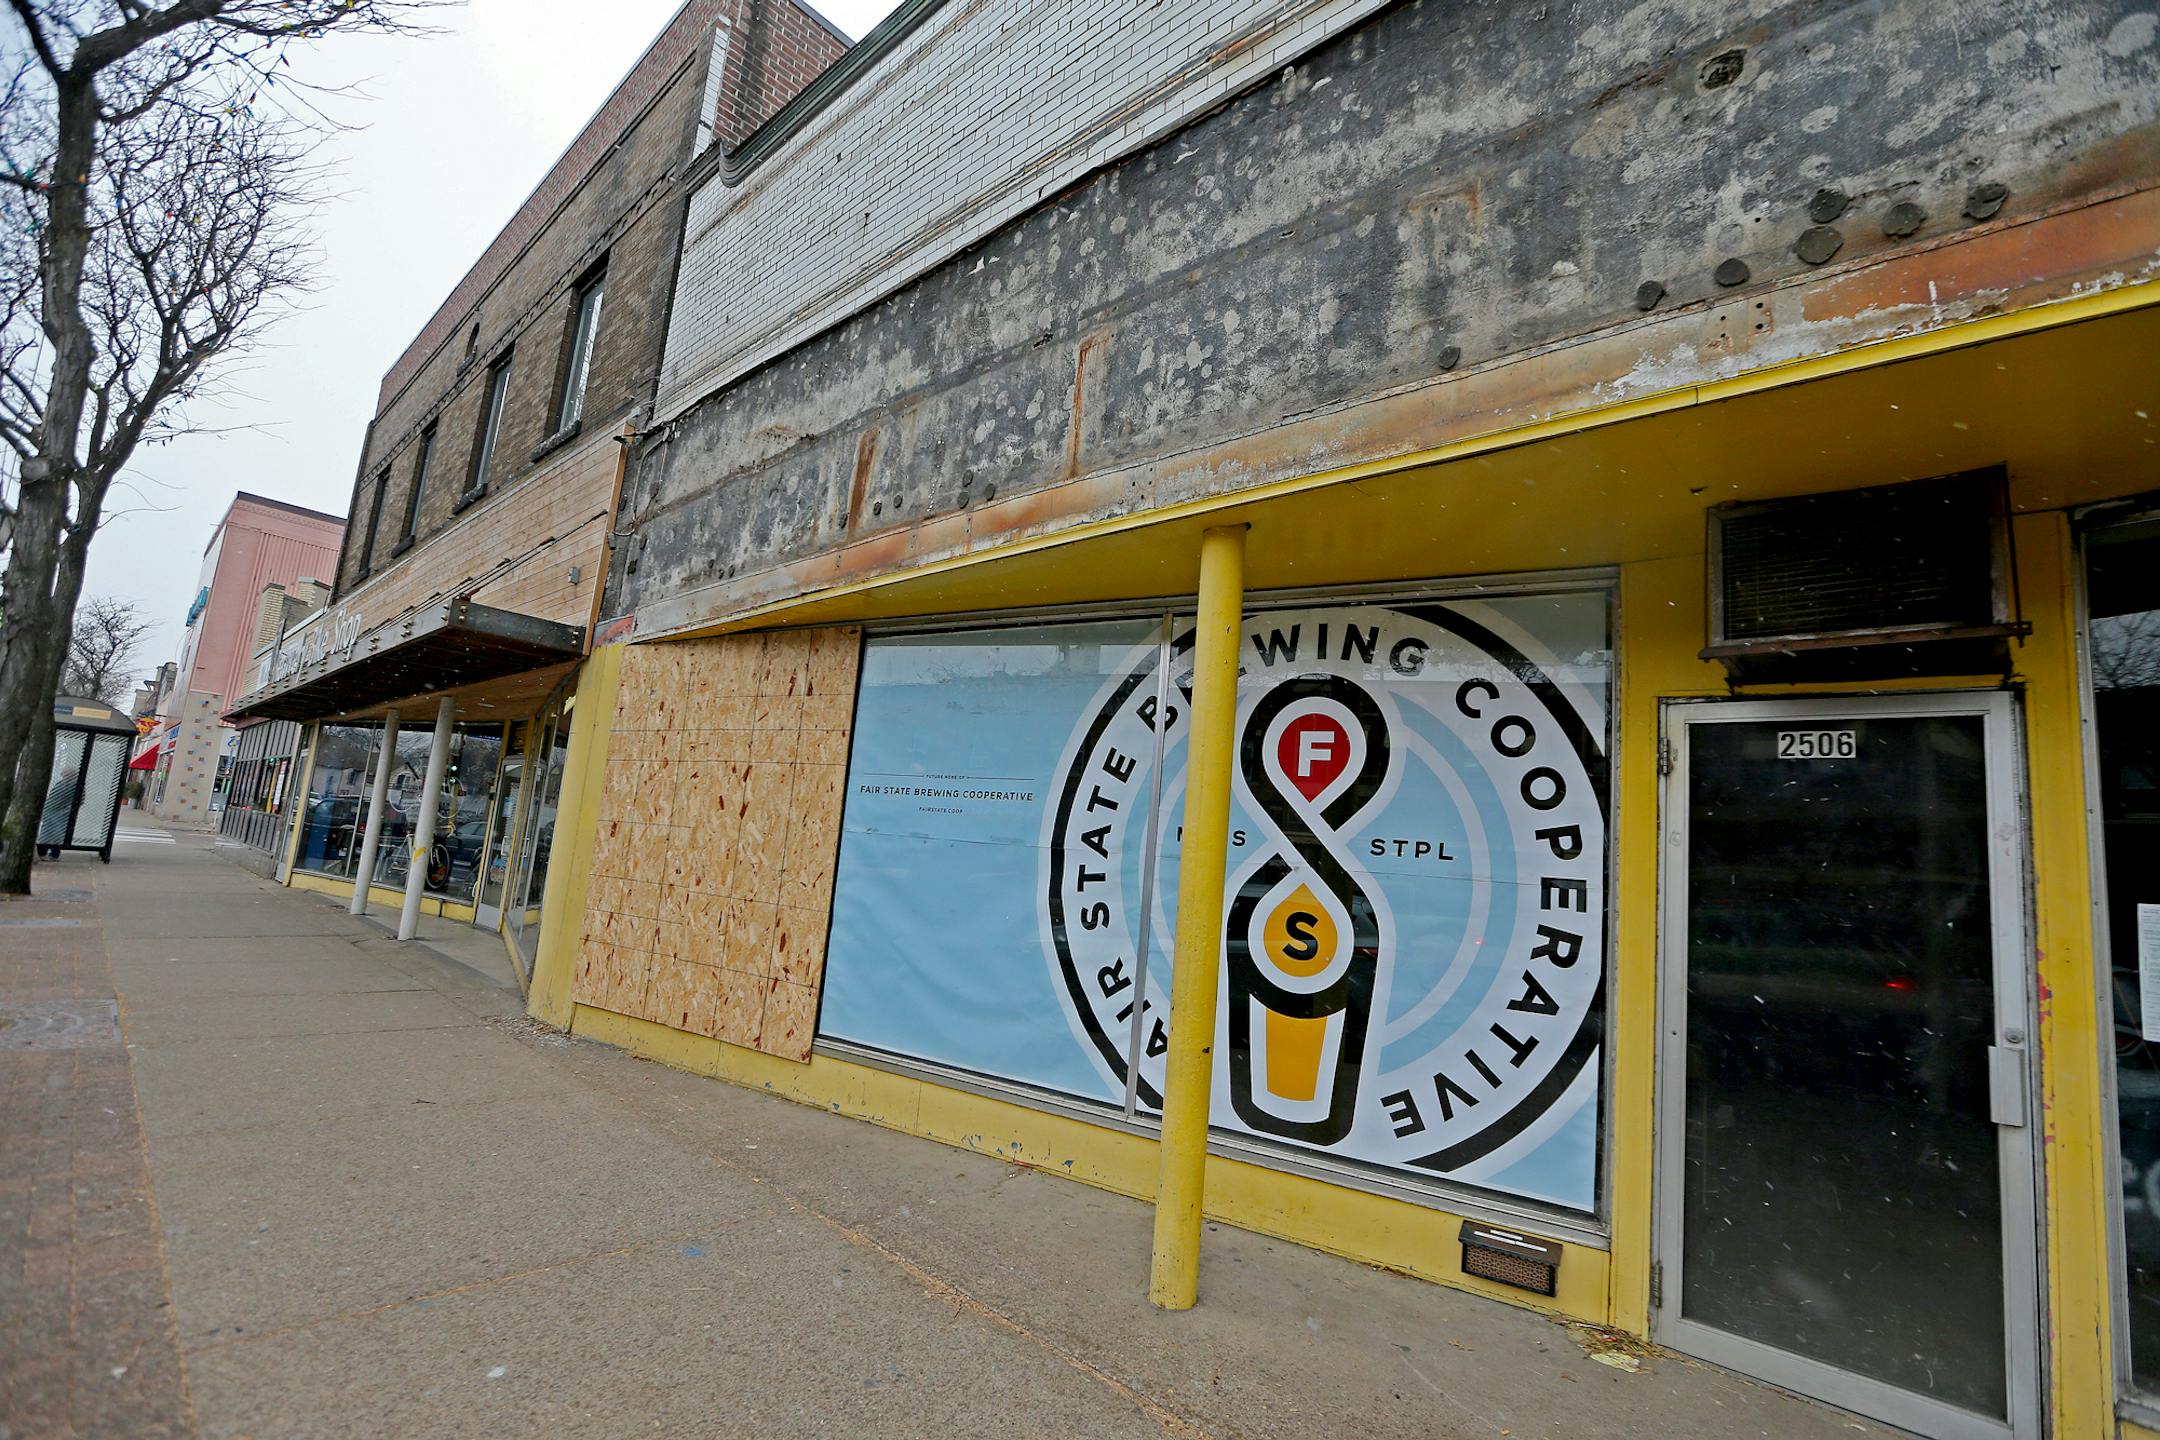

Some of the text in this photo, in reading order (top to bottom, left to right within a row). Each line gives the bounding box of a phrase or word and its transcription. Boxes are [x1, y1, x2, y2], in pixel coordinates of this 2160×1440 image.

[330, 607, 362, 660] Shop
[1297, 730, 1335, 777] F
[1780, 732, 1853, 757] 2506
[860, 785, 1033, 802] FAIR STATE BREWING COOPERATIVE
[1369, 838, 1454, 861] STPL
[1079, 622, 1588, 1139] AIR STATE BWING COOPERATIVE
[1282, 911, 1320, 961] S
